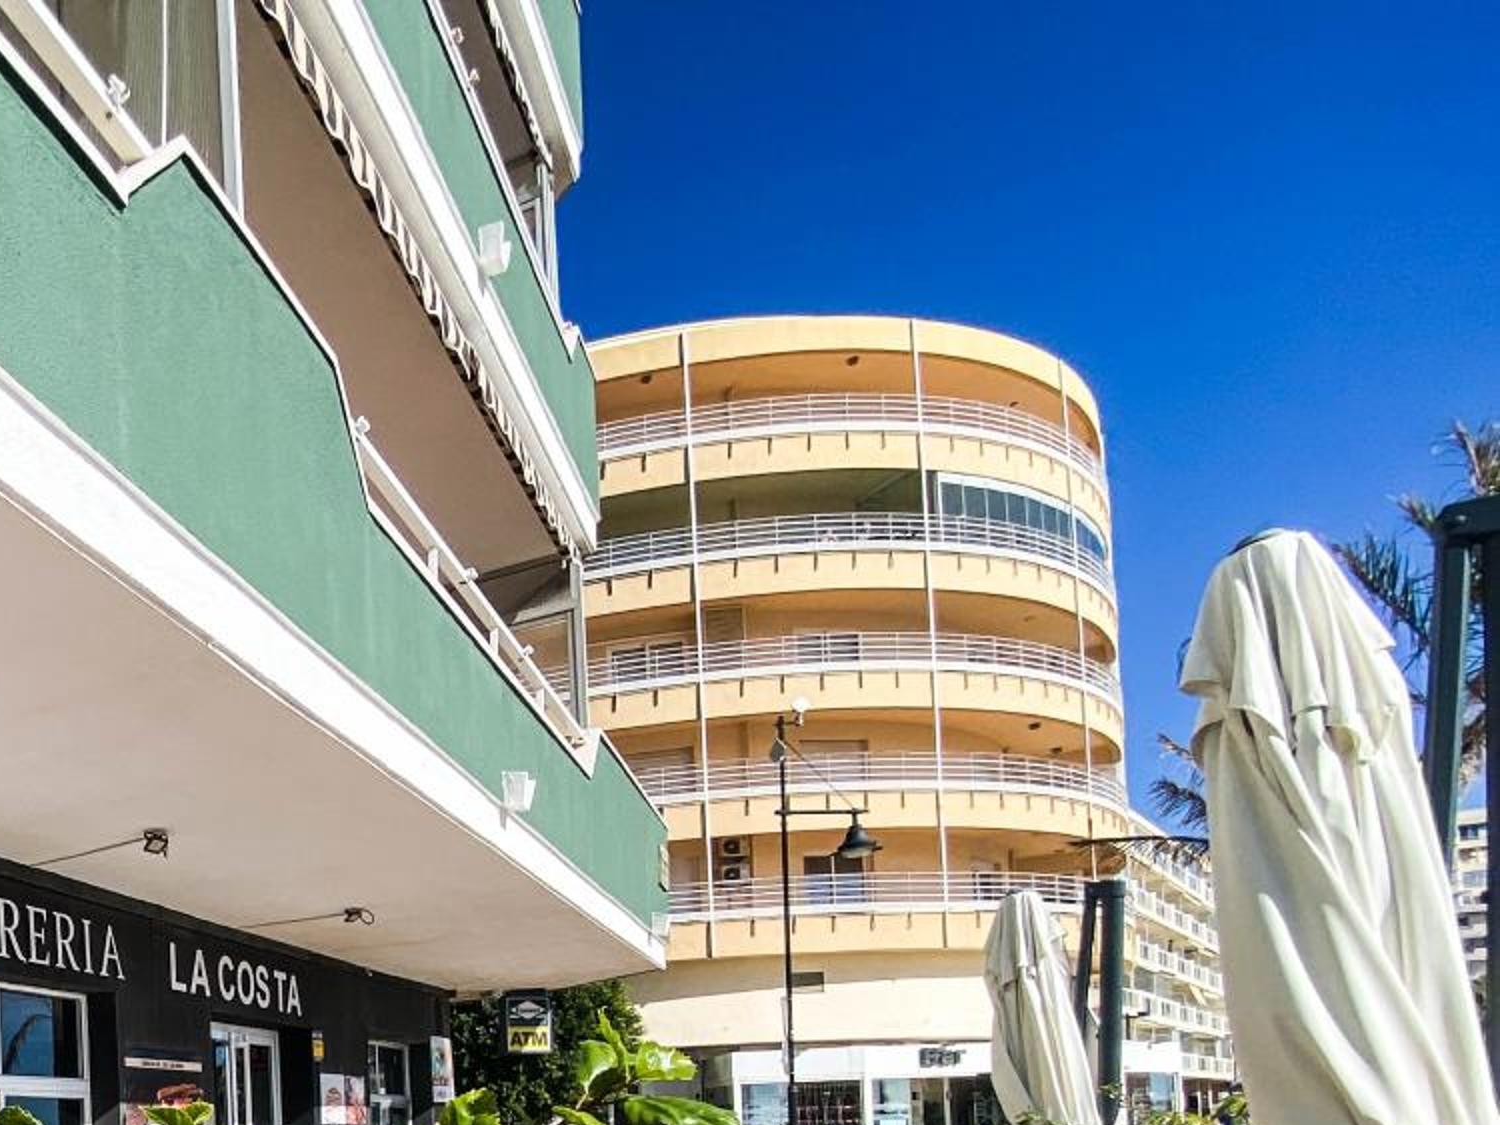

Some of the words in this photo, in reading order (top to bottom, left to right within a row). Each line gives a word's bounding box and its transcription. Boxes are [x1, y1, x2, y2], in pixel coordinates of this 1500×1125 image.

[169, 941, 212, 997] LA
[218, 955, 303, 1017] COSTA
[509, 1031, 548, 1047] ATM
